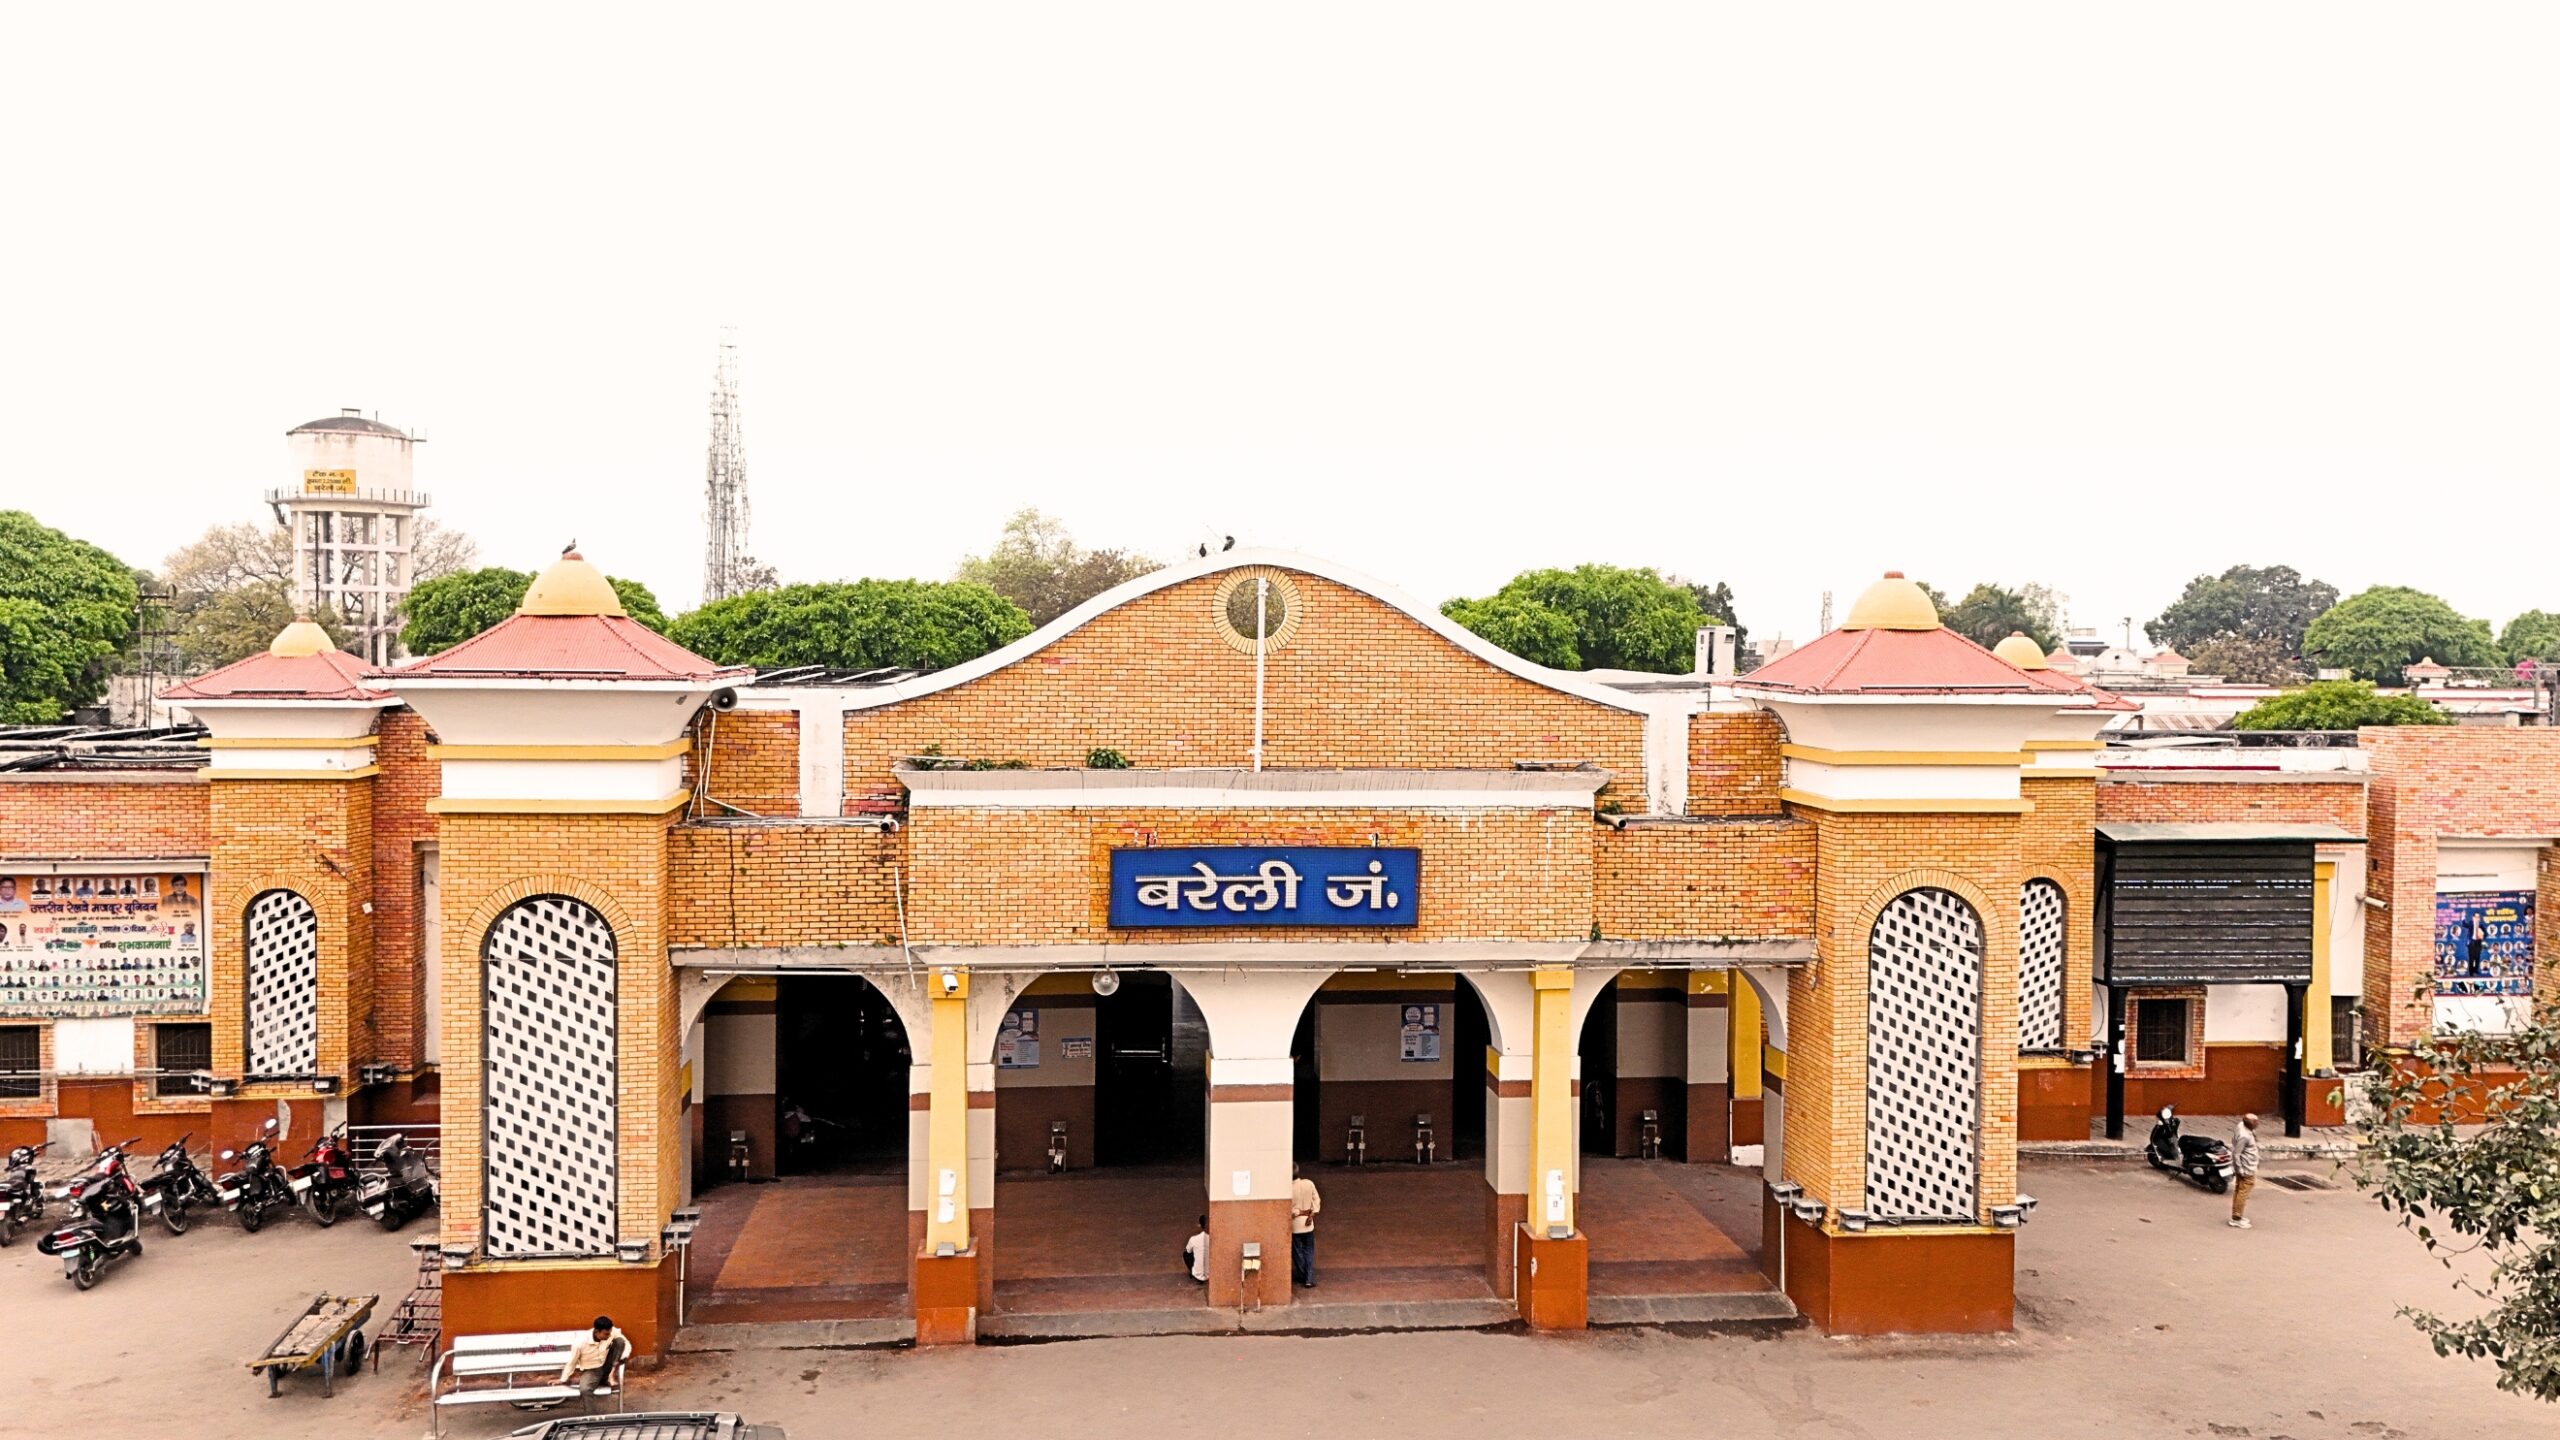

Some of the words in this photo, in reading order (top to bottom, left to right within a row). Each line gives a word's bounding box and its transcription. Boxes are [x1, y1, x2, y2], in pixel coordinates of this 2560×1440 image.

[1135, 859, 1303, 912] बरेली
[1326, 859, 1399, 910] जं.
[30, 901, 64, 914] उत्तरीय
[67, 900, 89, 914] रेलवे
[124, 899, 158, 915] यूनियन
